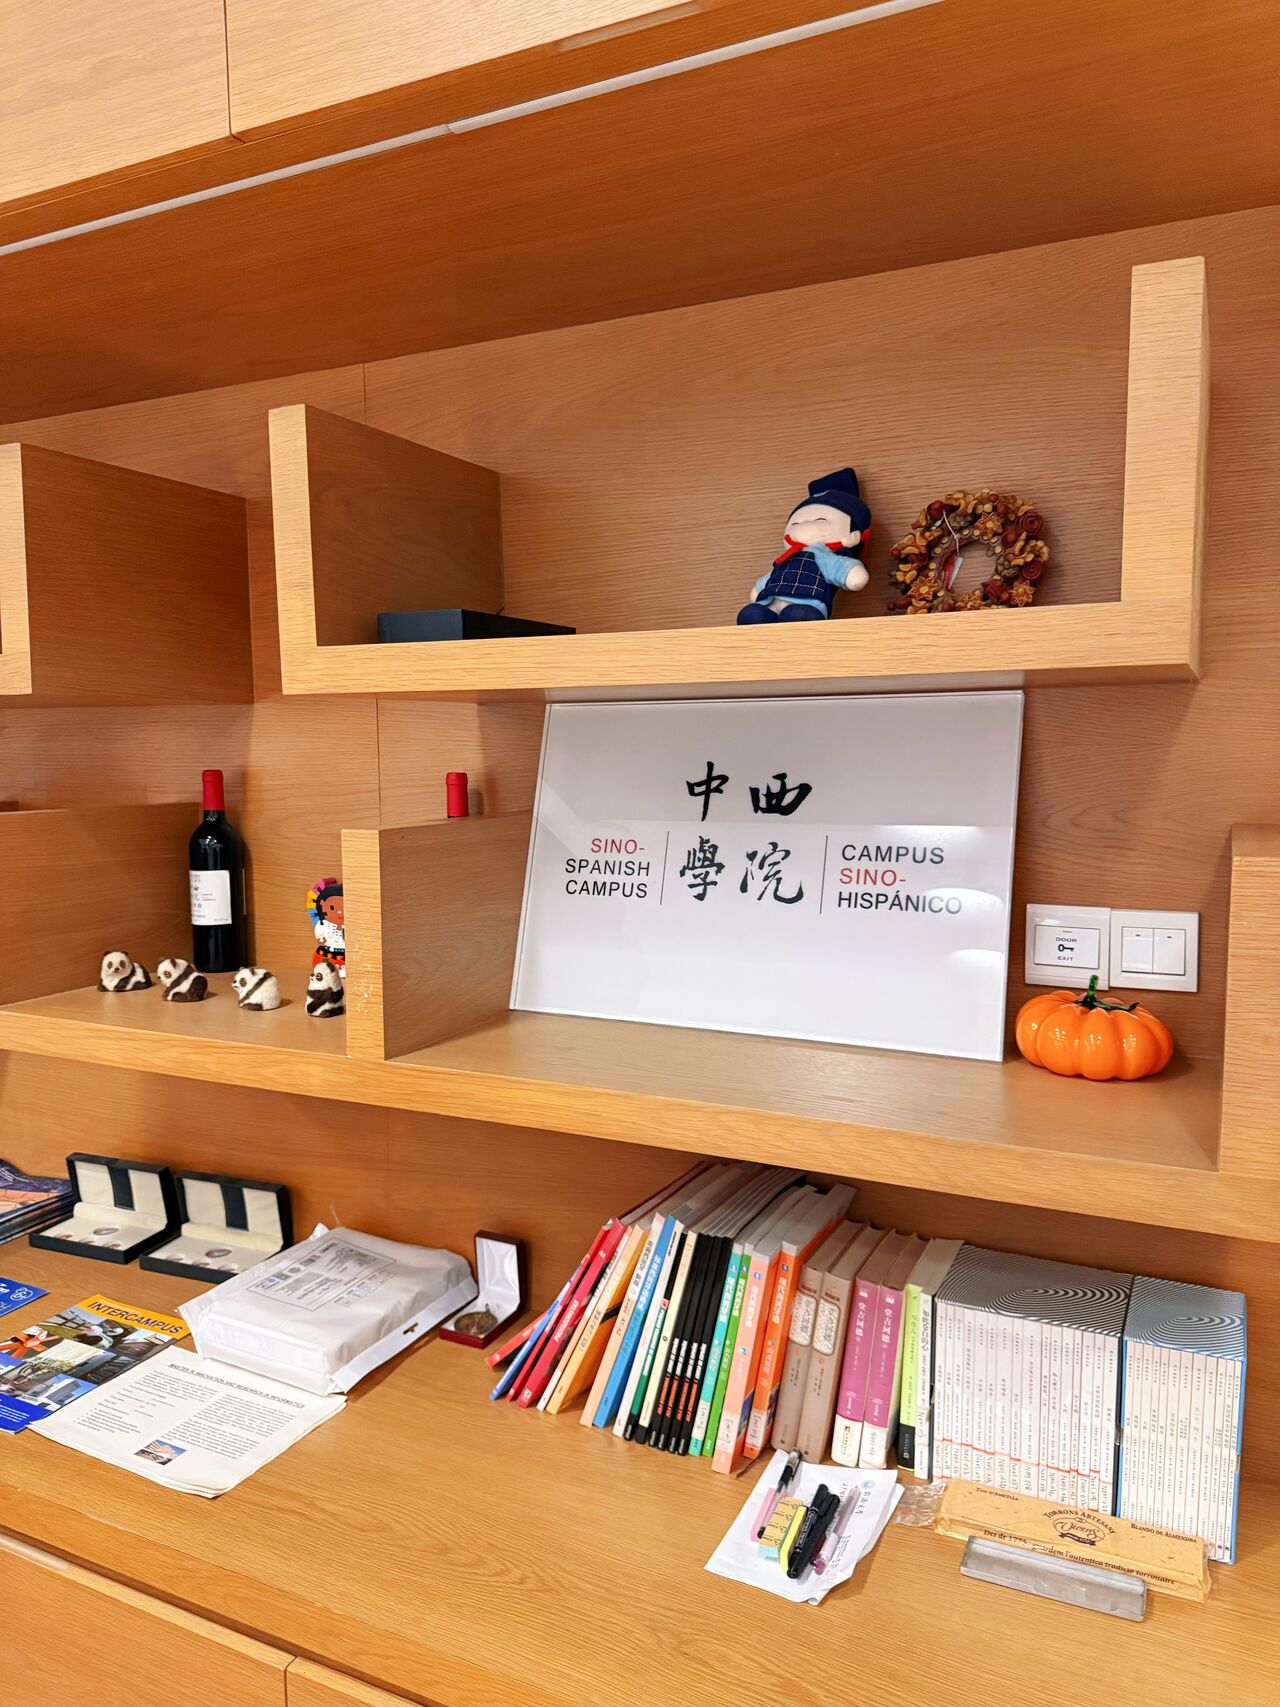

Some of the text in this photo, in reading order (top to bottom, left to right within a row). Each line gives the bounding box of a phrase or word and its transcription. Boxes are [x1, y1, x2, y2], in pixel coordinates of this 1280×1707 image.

[686, 761, 812, 821] 中西
[590, 838, 645, 855] SINO-
[841, 844, 945, 865] CAMPUS
[565, 859, 651, 877] SPANISH
[680, 836, 804, 904] 學院
[839, 867, 906, 886] SINO-
[565, 880, 648, 899] CAMPUS
[837, 888, 962, 915] HISPÁNICO
[88, 1301, 183, 1334] INTERCAMPUS
